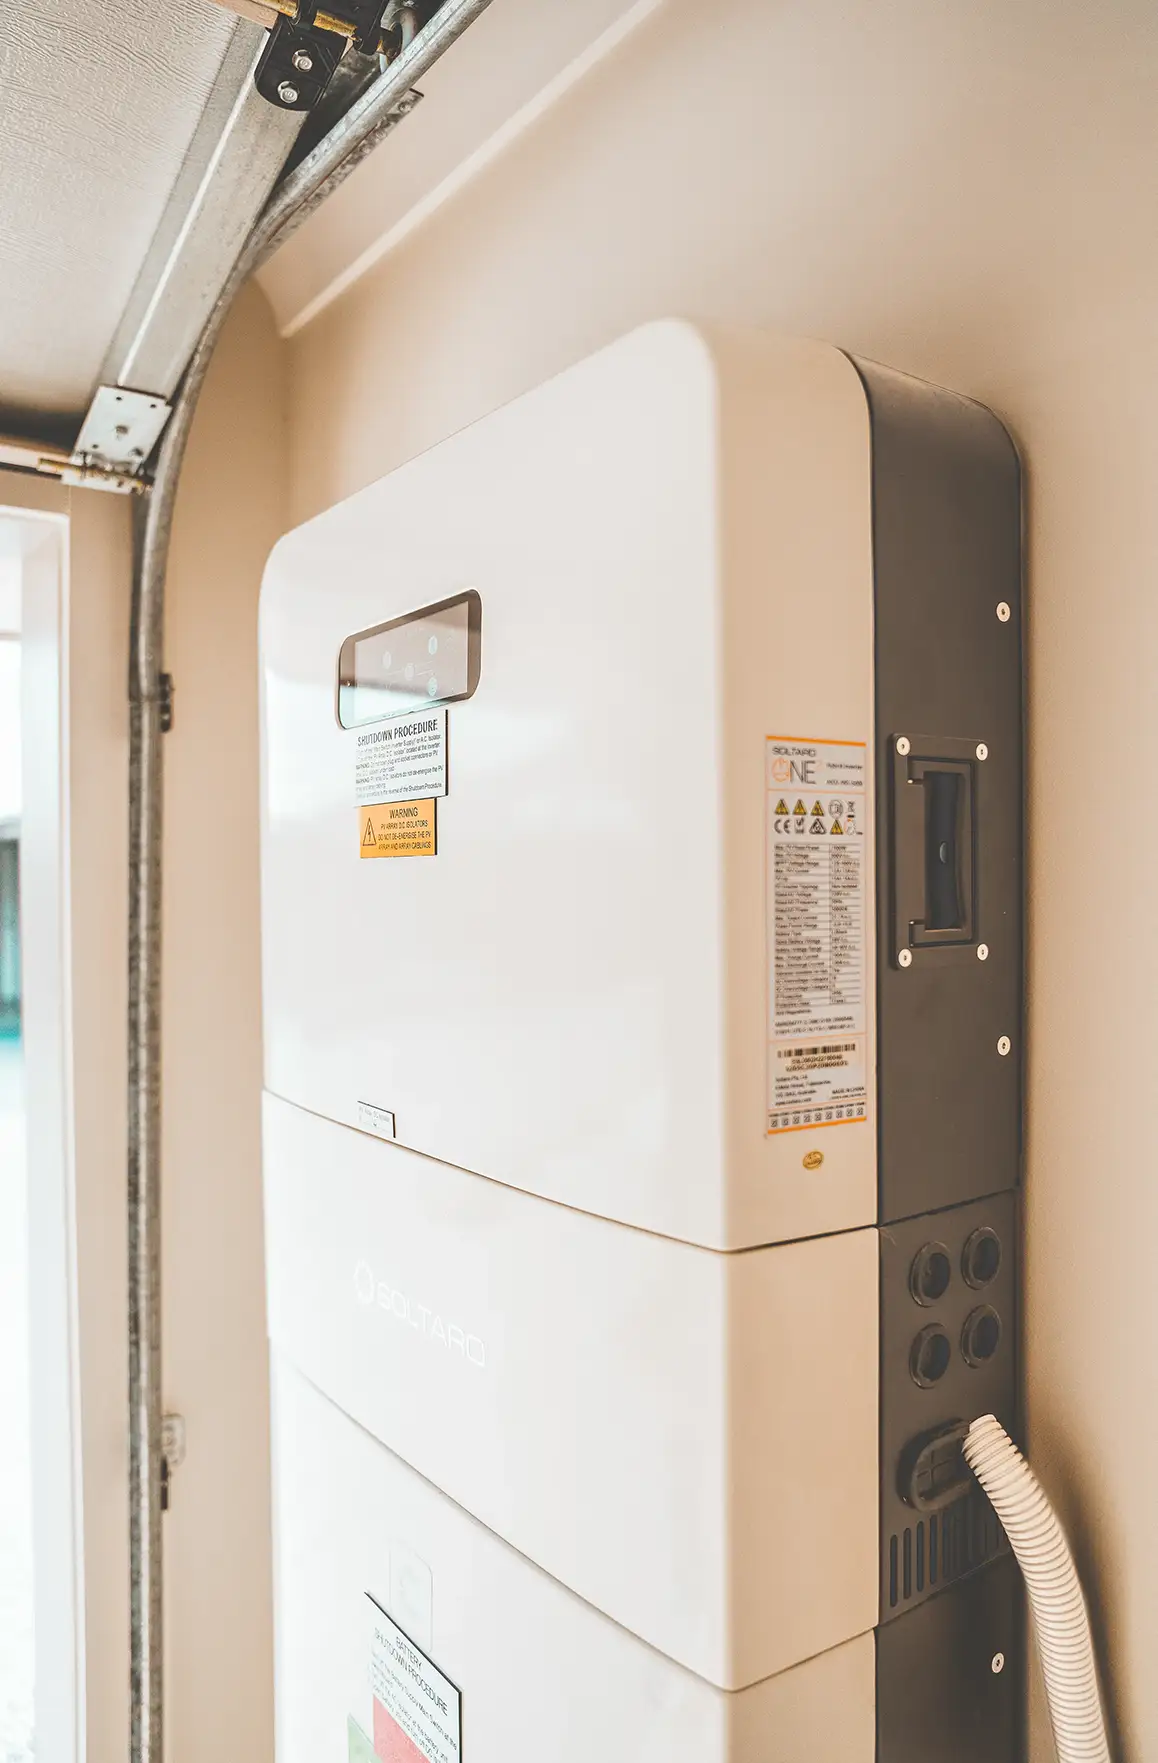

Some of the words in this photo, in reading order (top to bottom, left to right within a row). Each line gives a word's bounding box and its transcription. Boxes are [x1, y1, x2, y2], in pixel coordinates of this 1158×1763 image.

[358, 729, 392, 746] SHUTDOWN
[394, 719, 438, 739] PROCEDURE
[772, 747, 817, 757] SOLTARO
[389, 807, 418, 819] WARNING
[406, 820, 428, 828] ISOLATORS
[377, 1279, 486, 1367] SOLTARO
[396, 1636, 422, 1670] BATTERY
[374, 1627, 407, 1671] SHUTDOWN
[408, 1664, 448, 1716] PROCEDURE
